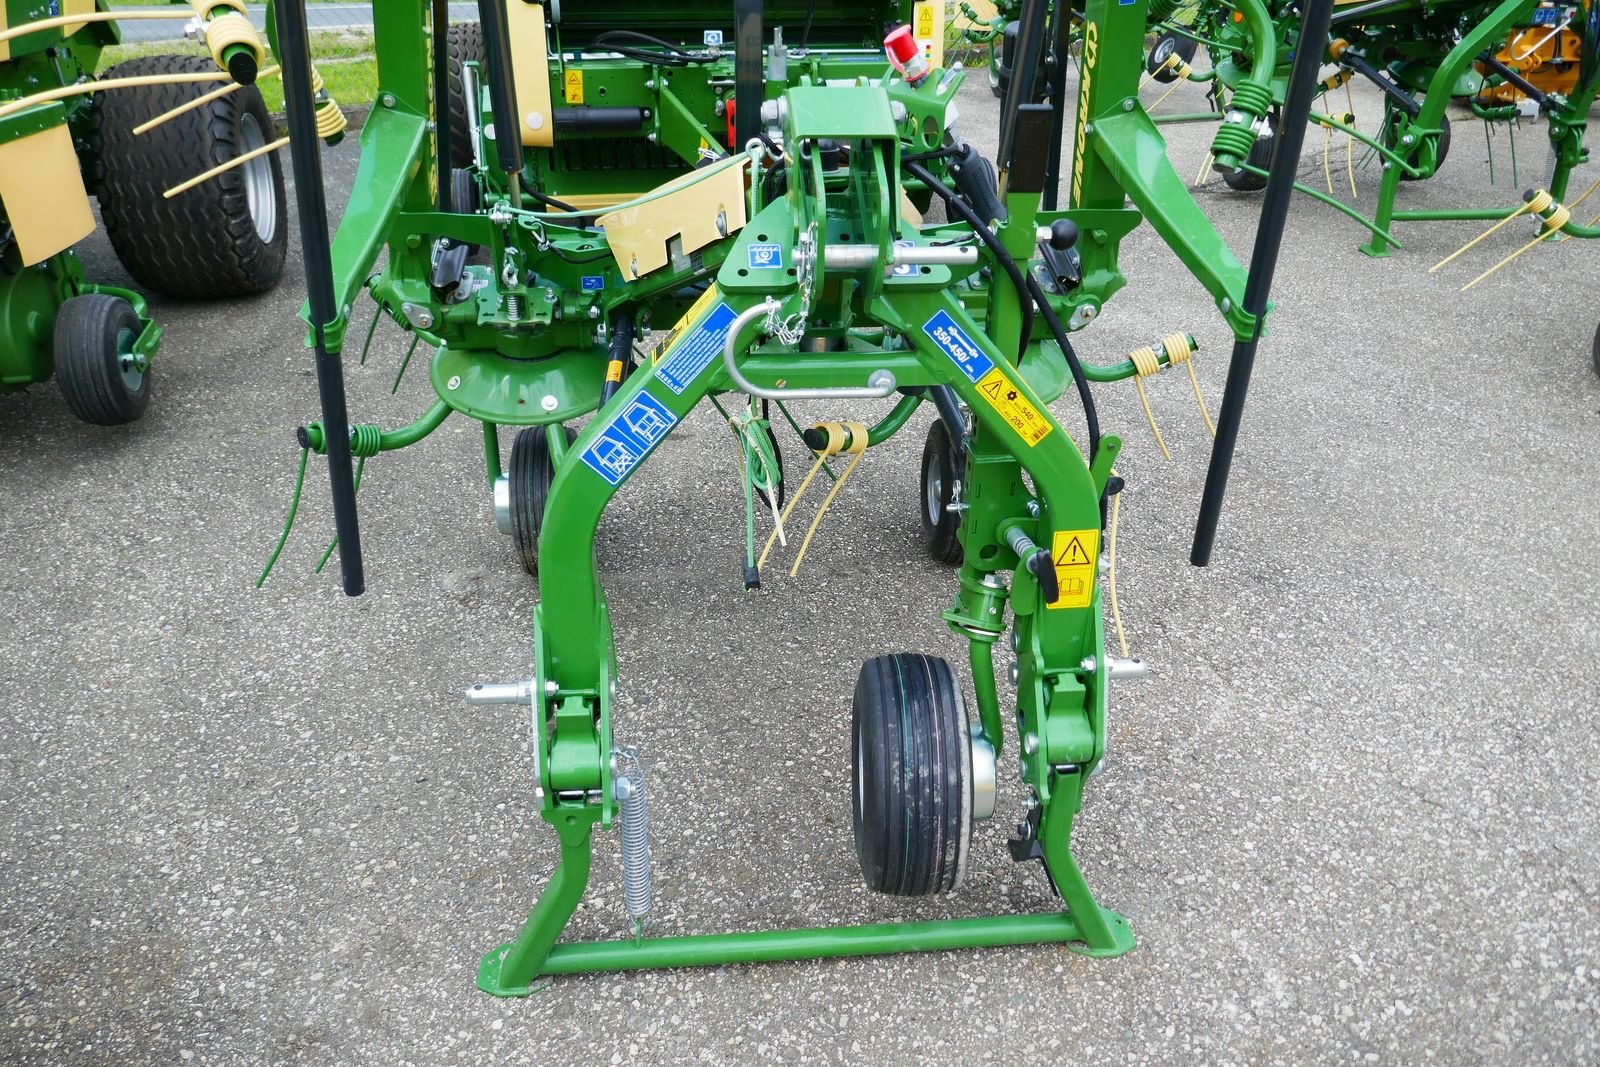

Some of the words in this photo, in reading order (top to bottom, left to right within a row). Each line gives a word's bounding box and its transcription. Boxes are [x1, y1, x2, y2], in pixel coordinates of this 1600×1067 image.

[1073, 64, 1091, 209] KRONE
[1020, 407, 1034, 420] 540
[1010, 416, 1024, 429] 200
